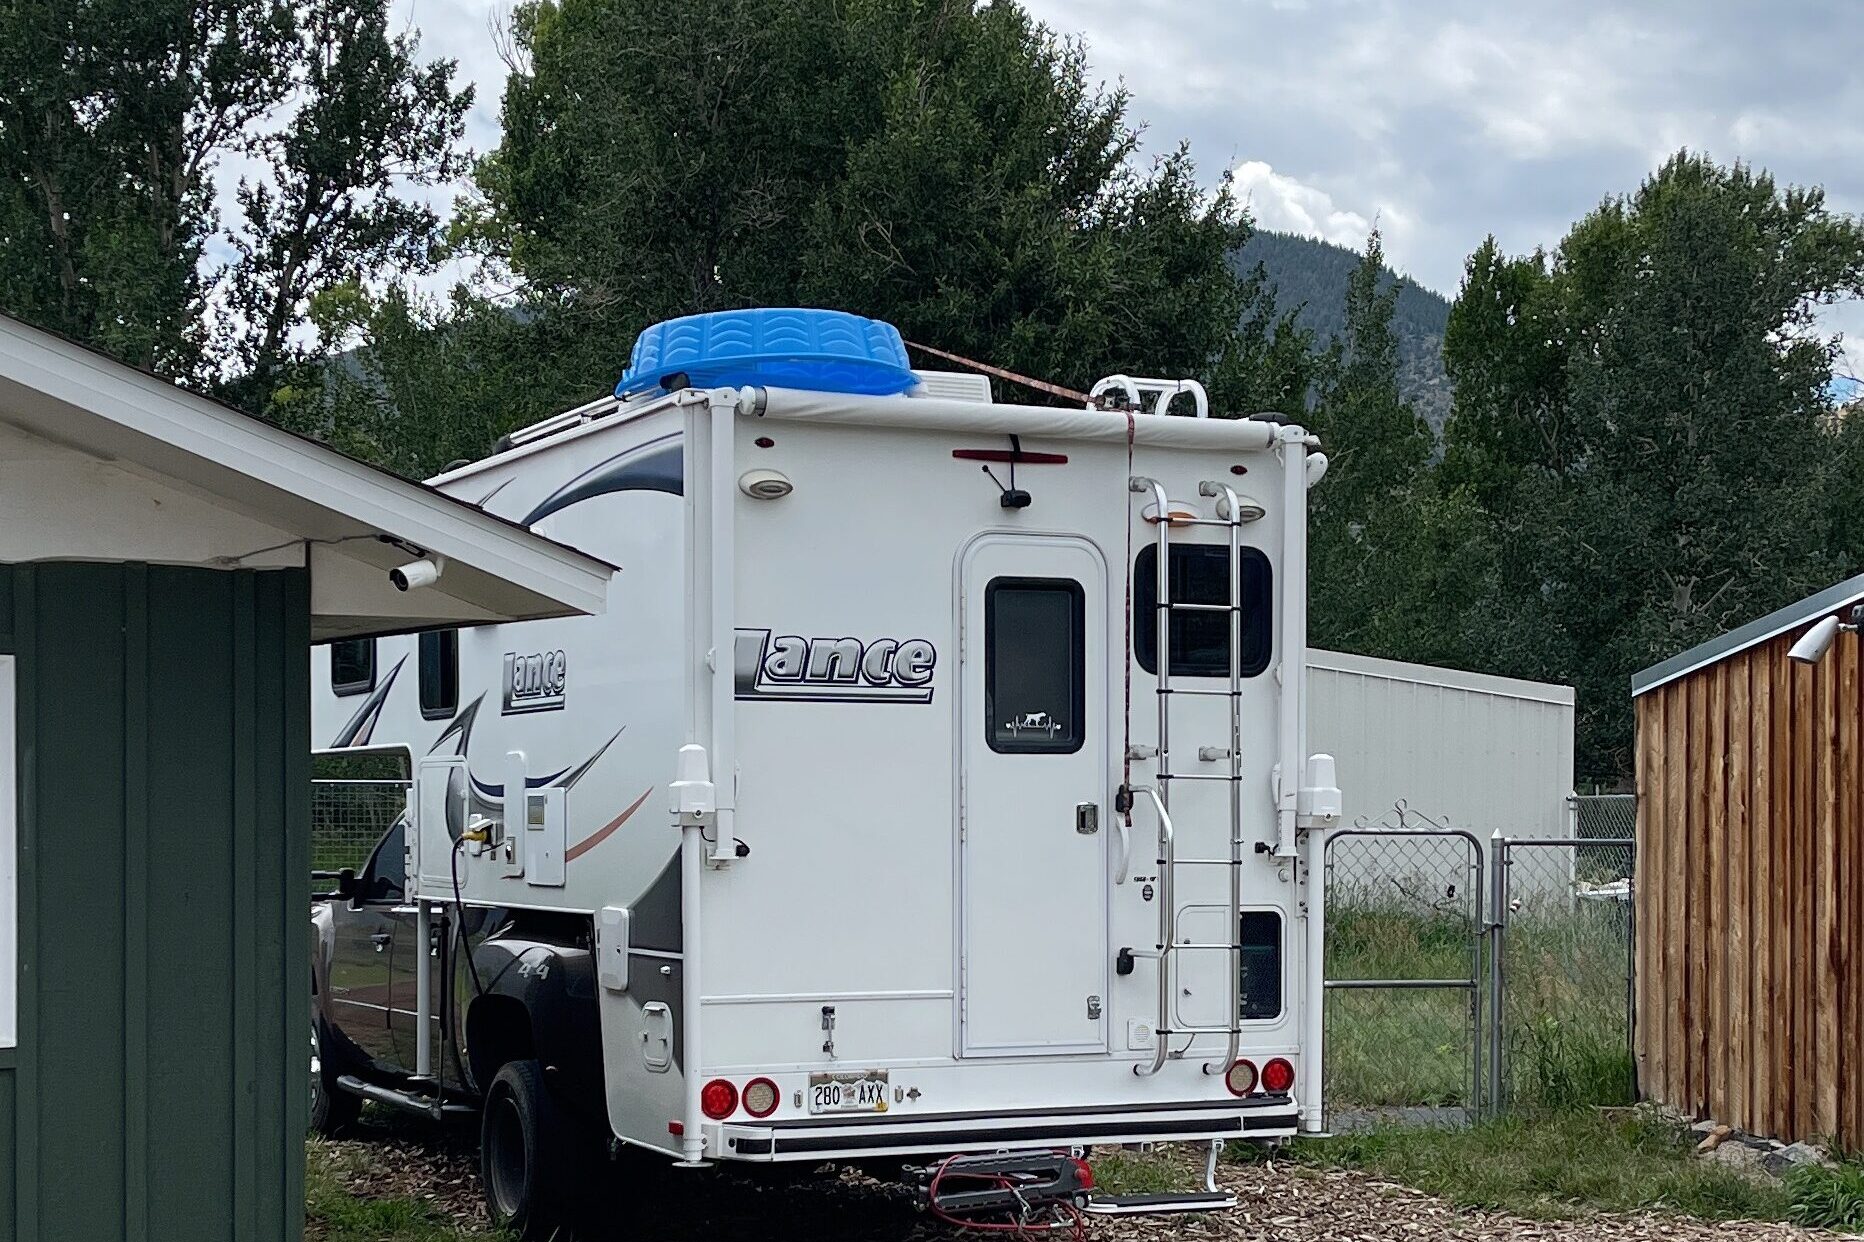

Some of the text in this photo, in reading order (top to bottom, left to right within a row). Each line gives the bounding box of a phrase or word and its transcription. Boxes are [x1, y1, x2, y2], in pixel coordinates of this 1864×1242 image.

[517, 962, 550, 980] 44
[815, 1083, 883, 1106] 280 AXX
